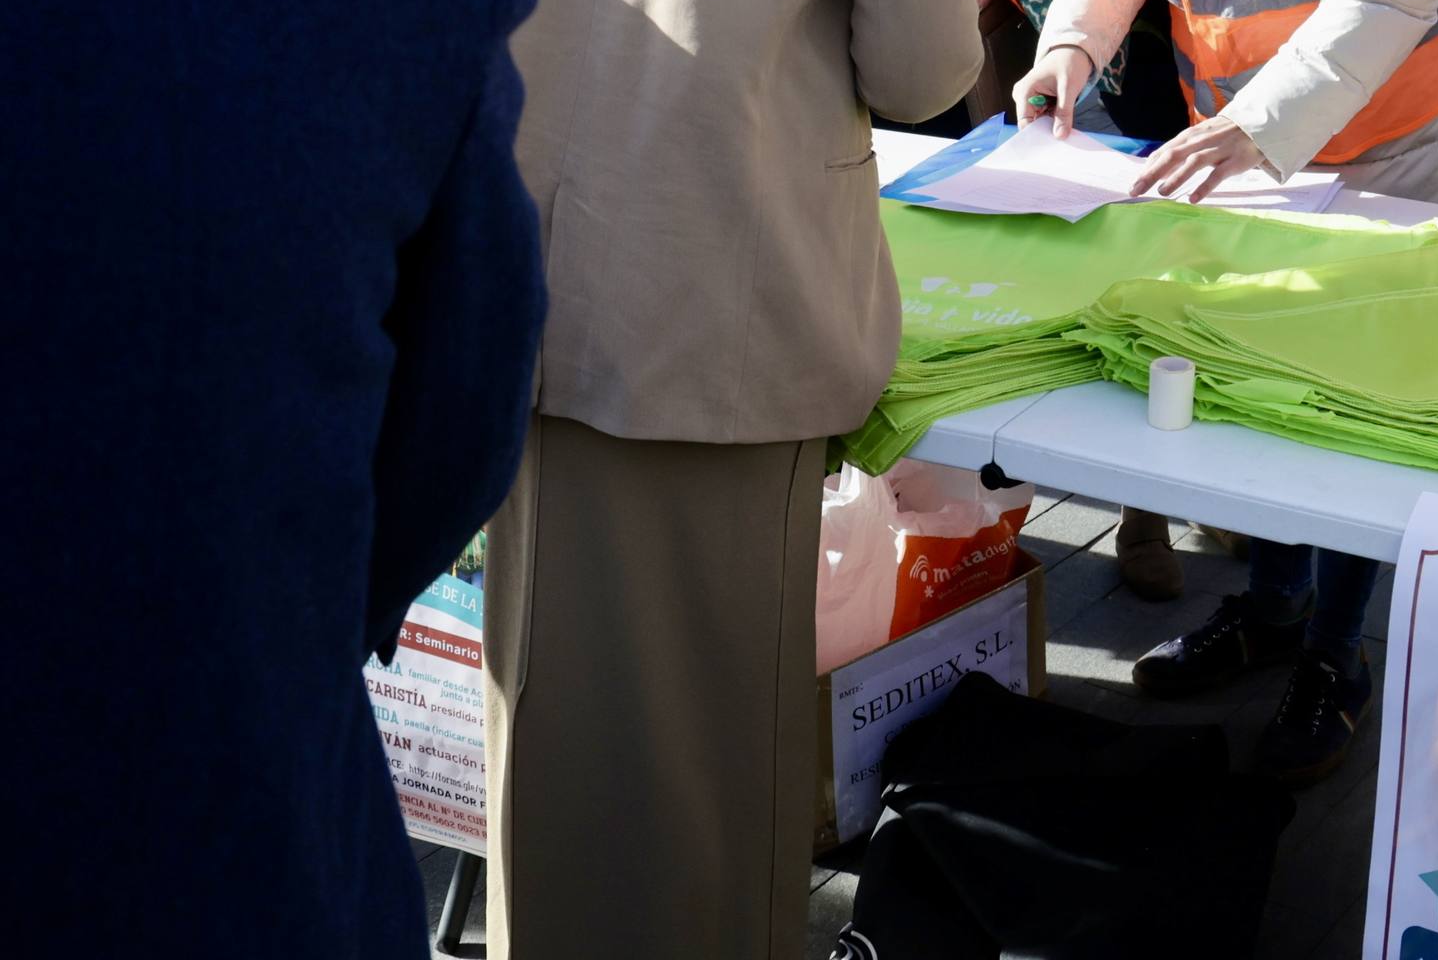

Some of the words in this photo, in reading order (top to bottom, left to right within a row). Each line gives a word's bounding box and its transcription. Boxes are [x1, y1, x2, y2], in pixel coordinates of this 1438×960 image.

[442, 584, 459, 603] DE
[461, 593, 477, 613] LA
[415, 631, 479, 660] Seminario
[975, 630, 1014, 664] S.L.
[408, 668, 441, 685] familiar
[443, 679, 469, 694] desde
[440, 689, 463, 702] junto
[431, 703, 477, 724] presidida
[404, 718, 430, 732] paella
[432, 724, 466, 742] (indicar
[418, 743, 477, 769] actuación
[402, 777, 452, 799] JORNADA
[455, 792, 477, 807] POR
[428, 802, 439, 813] AL
[453, 809, 465, 821] DE
